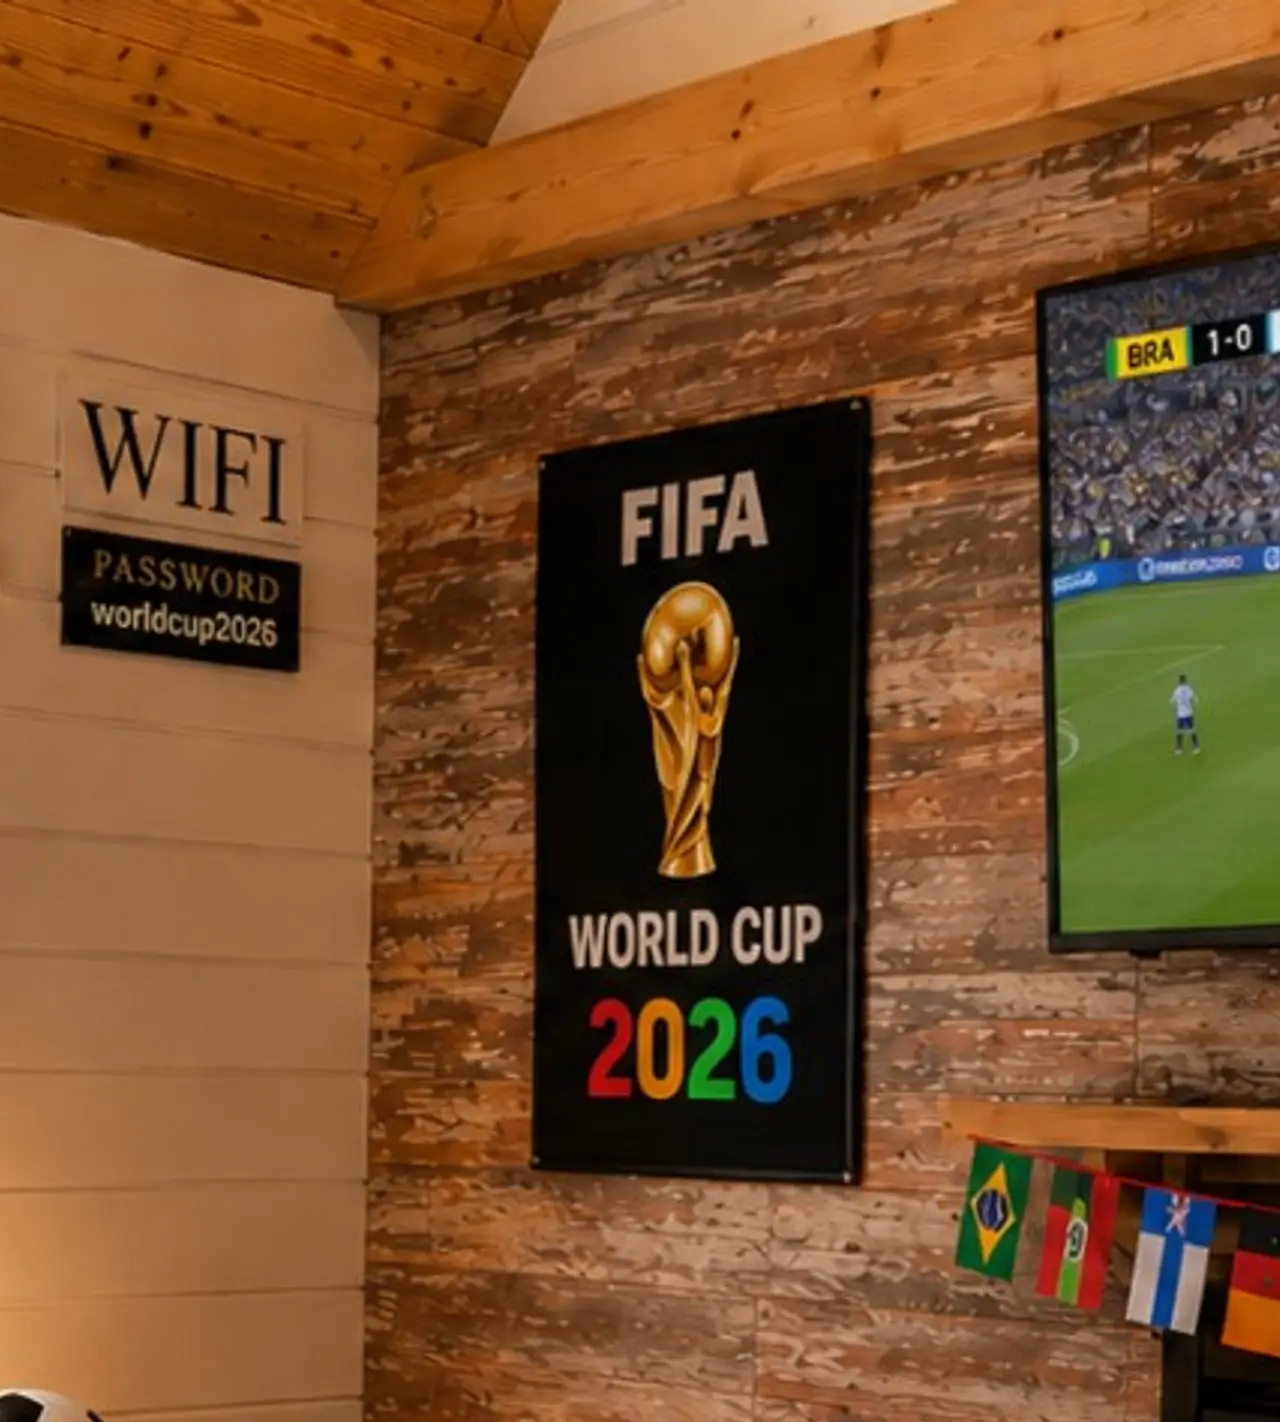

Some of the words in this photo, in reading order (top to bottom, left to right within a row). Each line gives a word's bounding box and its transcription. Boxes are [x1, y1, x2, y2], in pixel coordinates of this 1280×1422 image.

[1126, 338, 1176, 371] BRA
[1209, 324, 1253, 357] 1-0
[80, 400, 287, 527] WIFI
[622, 469, 769, 567] FIFA
[93, 549, 281, 605] PASSWORD
[90, 600, 279, 650] worldcup2026
[569, 910, 720, 969] WORLD
[731, 905, 823, 966] CUP
[588, 995, 792, 1104] 2026
